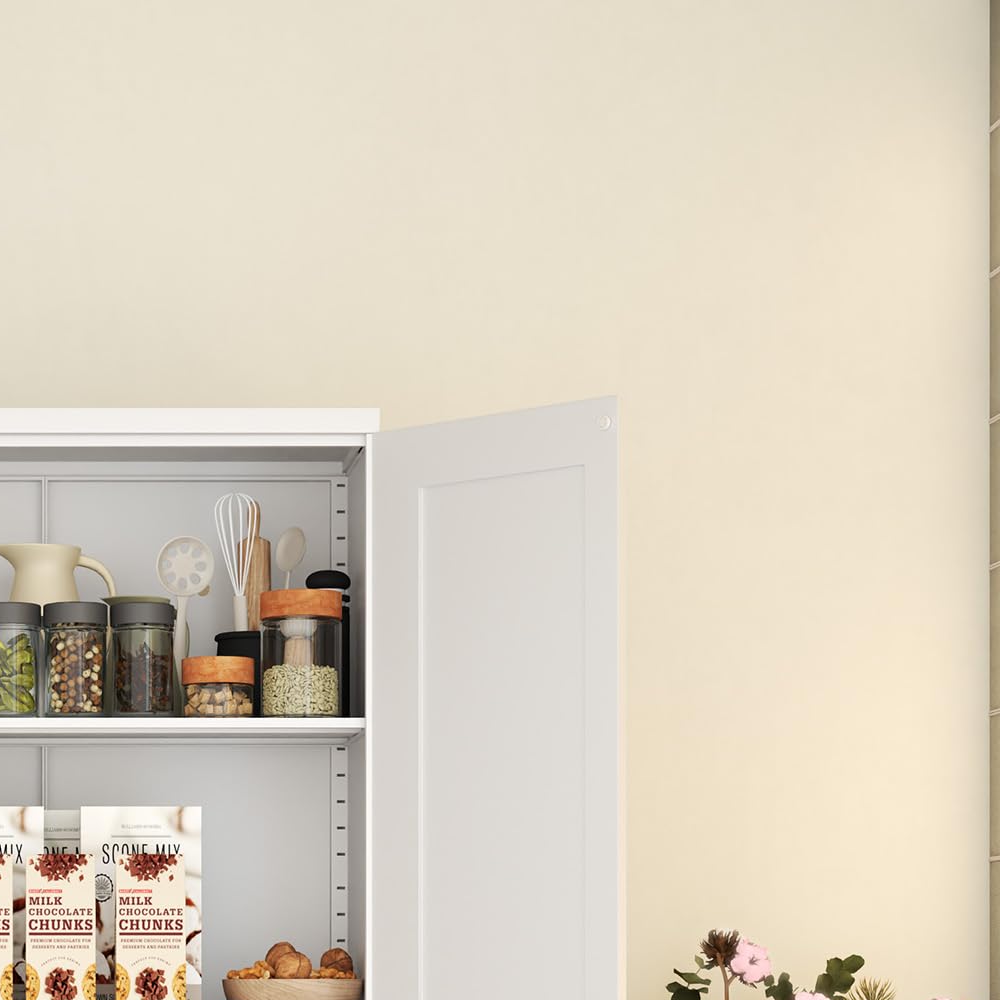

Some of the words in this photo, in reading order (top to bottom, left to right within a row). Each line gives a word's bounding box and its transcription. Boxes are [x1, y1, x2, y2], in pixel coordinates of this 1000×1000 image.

[29, 896, 62, 905] MILK
[119, 896, 152, 905] MILK
[29, 919, 93, 930] CHUNKS
[119, 919, 183, 930] CHUNKS
